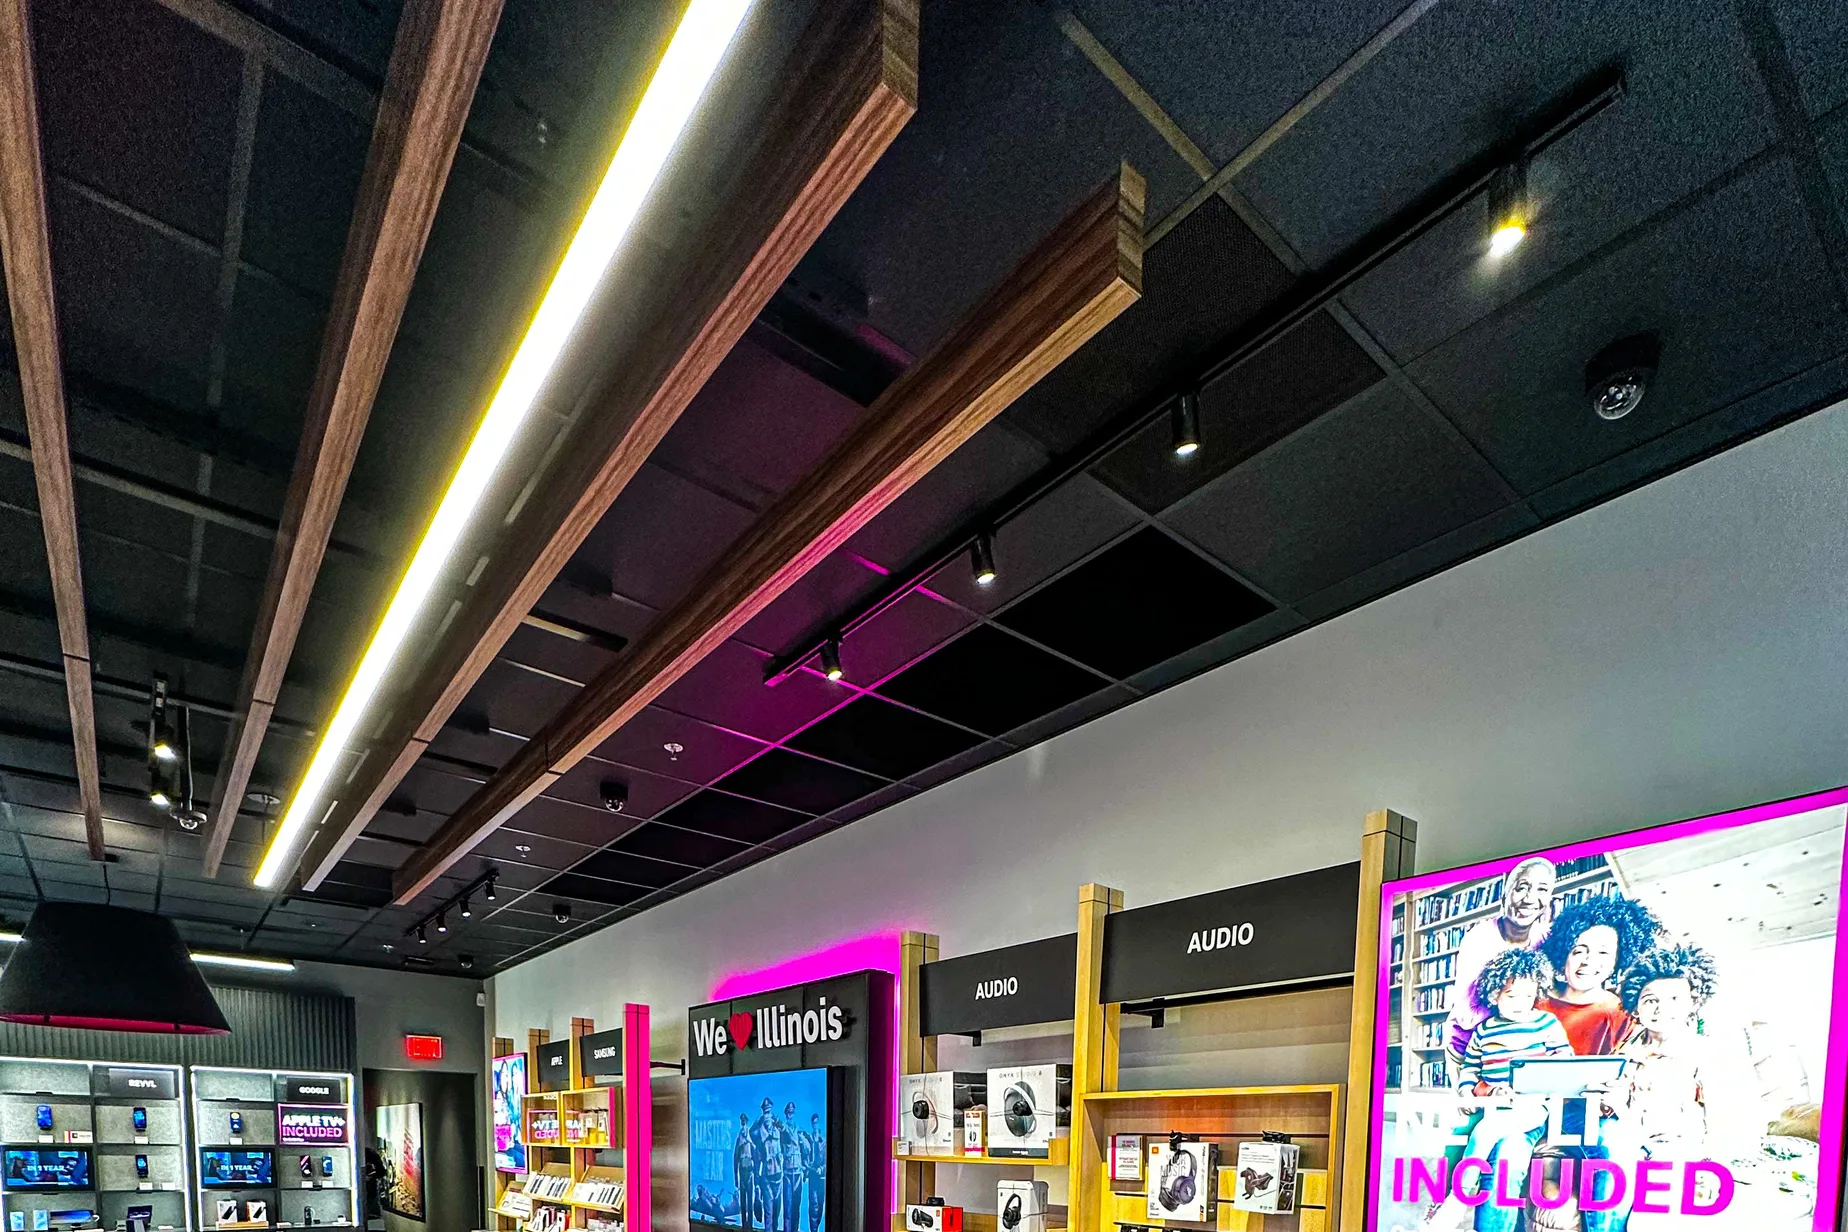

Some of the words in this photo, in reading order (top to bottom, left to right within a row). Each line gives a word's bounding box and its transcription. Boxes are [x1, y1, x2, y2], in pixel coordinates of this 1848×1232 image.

[1187, 922, 1254, 954] AUDIO
[975, 976, 1018, 1000] AUDIO
[693, 1017, 727, 1057] We
[756, 996, 843, 1049] Illinois
[299, 1086, 330, 1095] GOOGLE
[282, 1114, 321, 1127] APPLE
[282, 1126, 343, 1138] INCLUDED
[1392, 1157, 1735, 1216] INCLUDED
